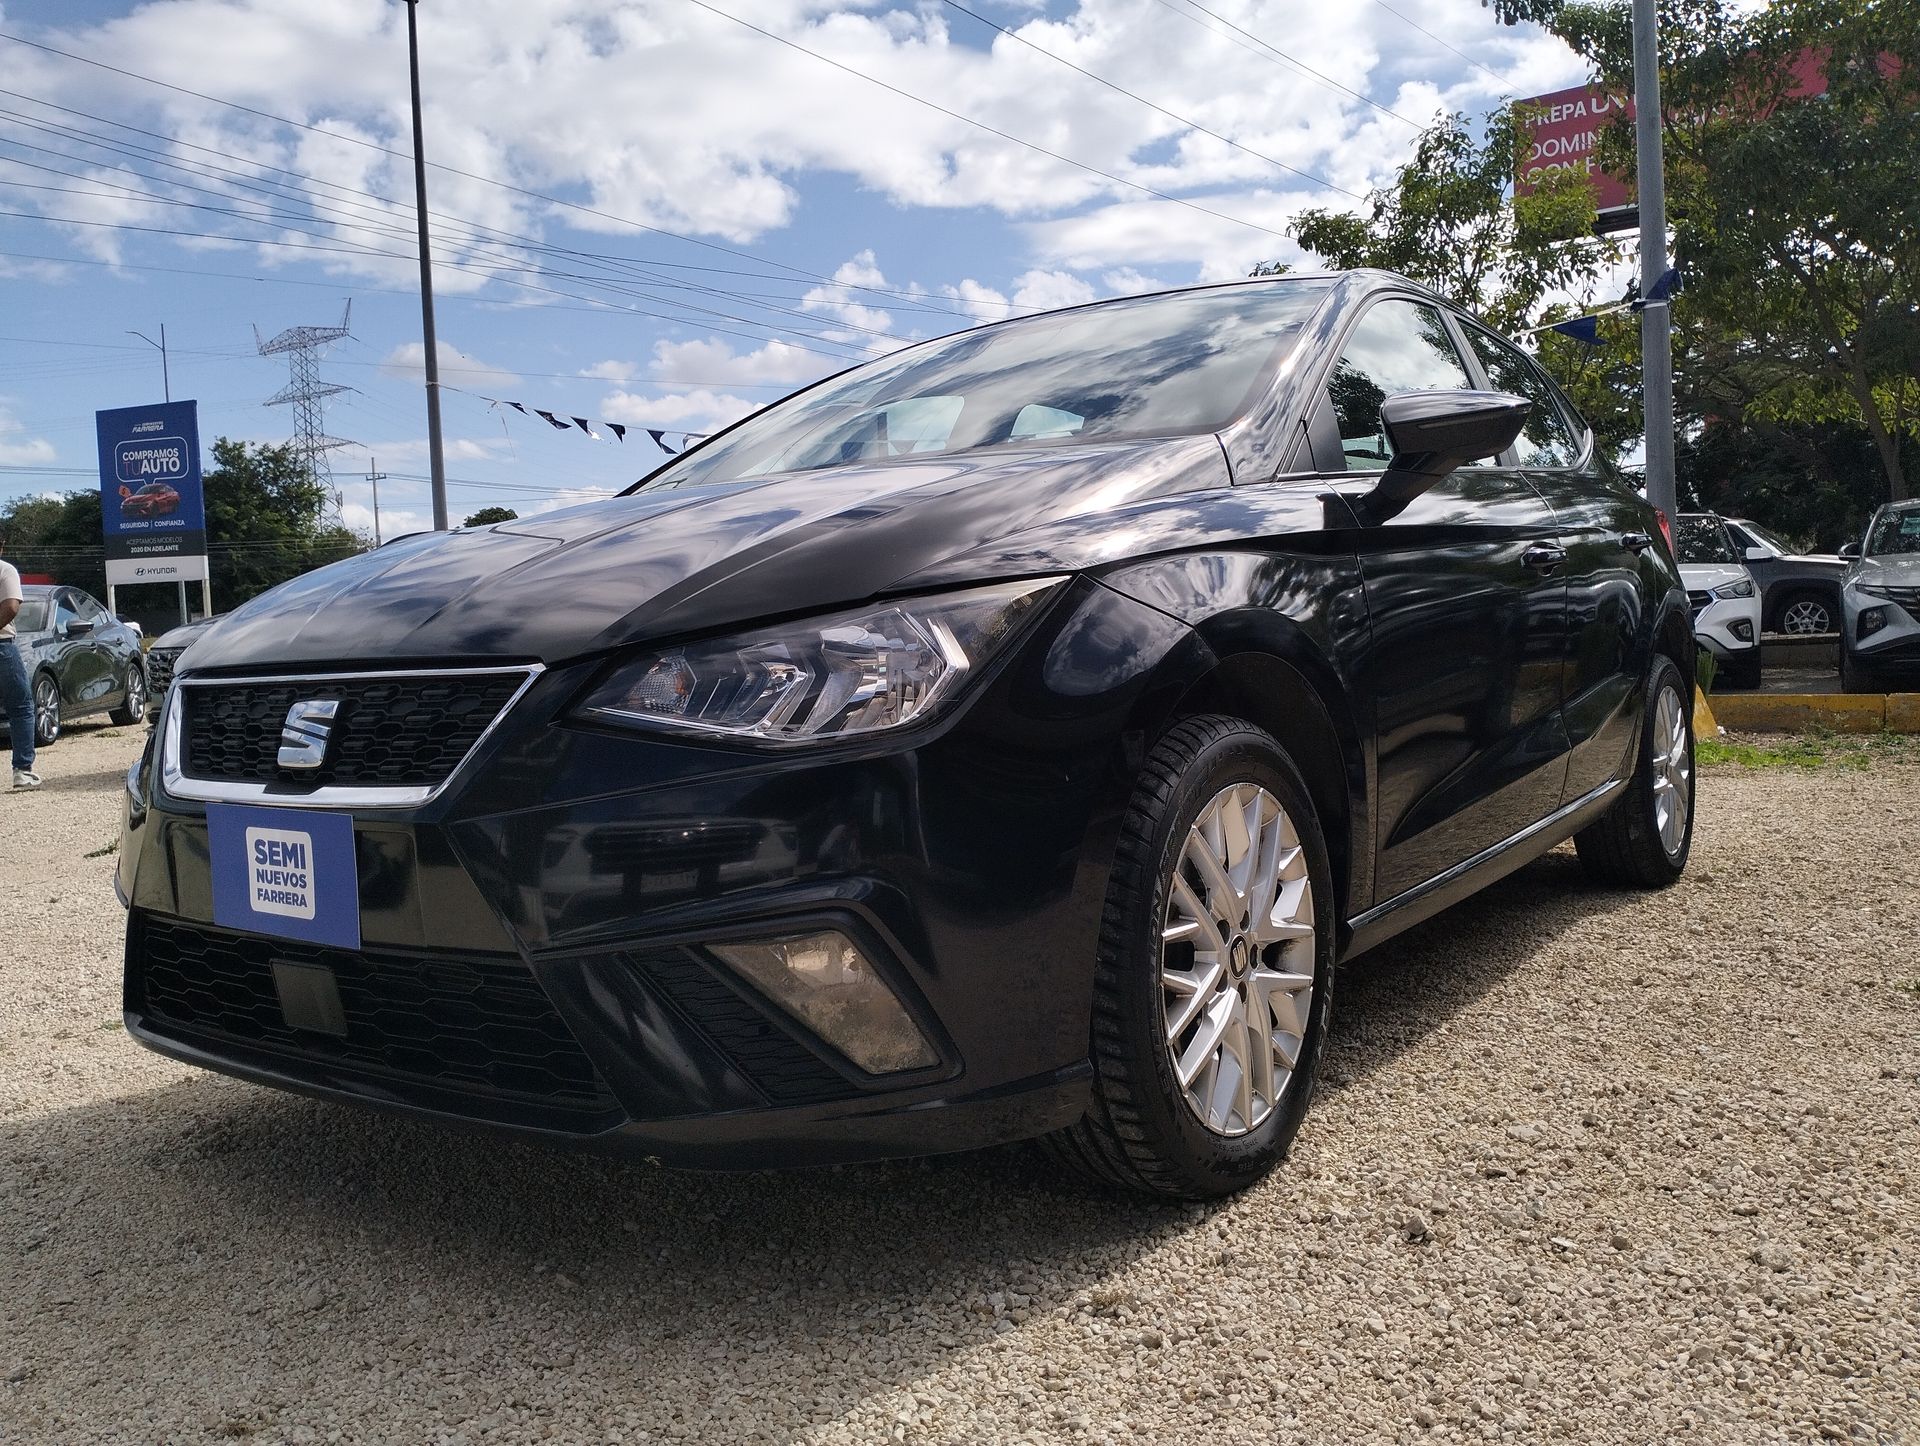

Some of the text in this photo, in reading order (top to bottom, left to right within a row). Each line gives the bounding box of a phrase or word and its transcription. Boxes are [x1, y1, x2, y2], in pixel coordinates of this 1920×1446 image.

[122, 447, 179, 461] COMPRAMOS
[141, 457, 180, 474] AUTO
[120, 519, 185, 529] SEGURIDAD CONFIANZA
[254, 839, 306, 869] SEMI
[256, 868, 307, 889] NUEVOS
[257, 888, 308, 908] FARRERA
